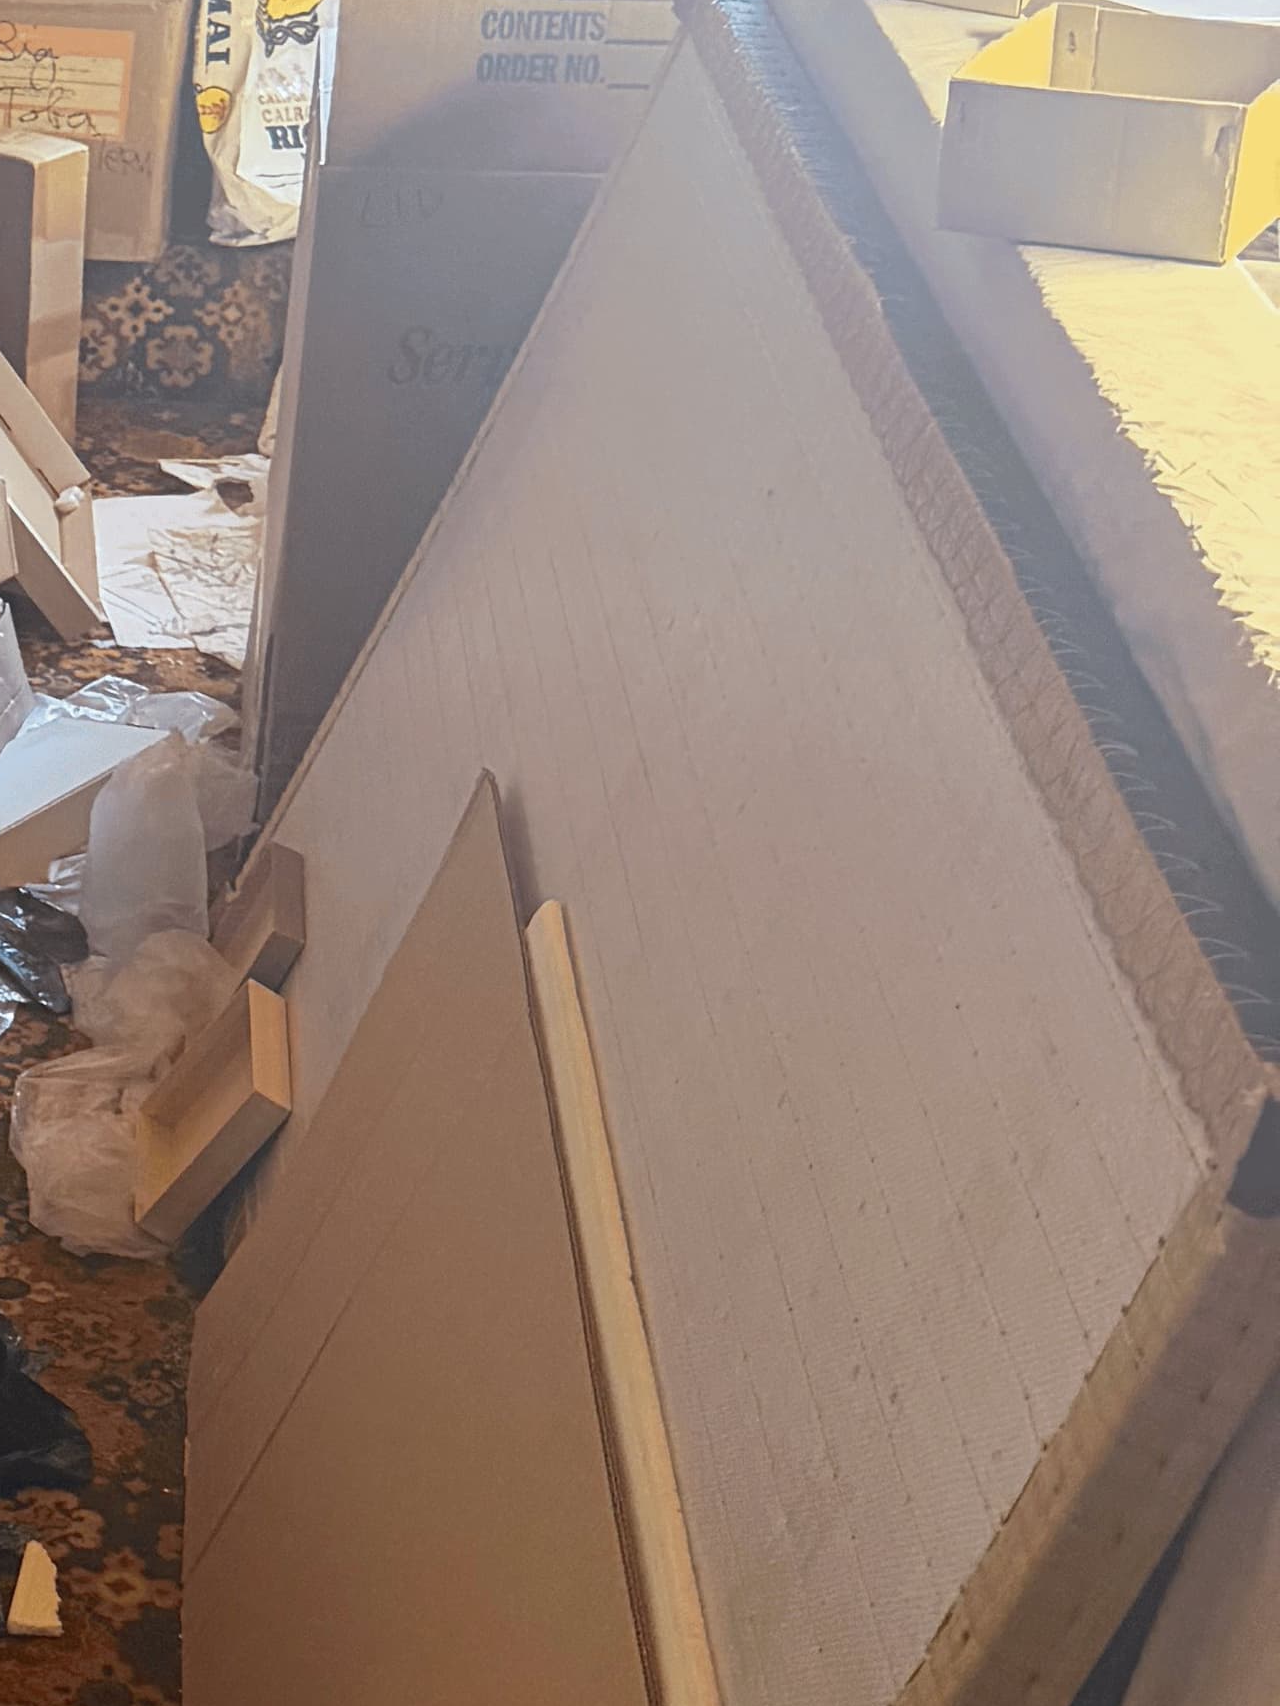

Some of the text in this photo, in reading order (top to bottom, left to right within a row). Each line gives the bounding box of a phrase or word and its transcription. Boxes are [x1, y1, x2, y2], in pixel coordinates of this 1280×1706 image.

[480, 10, 608, 42] CONTENTS
[476, 53, 608, 86] ORDER NO.
